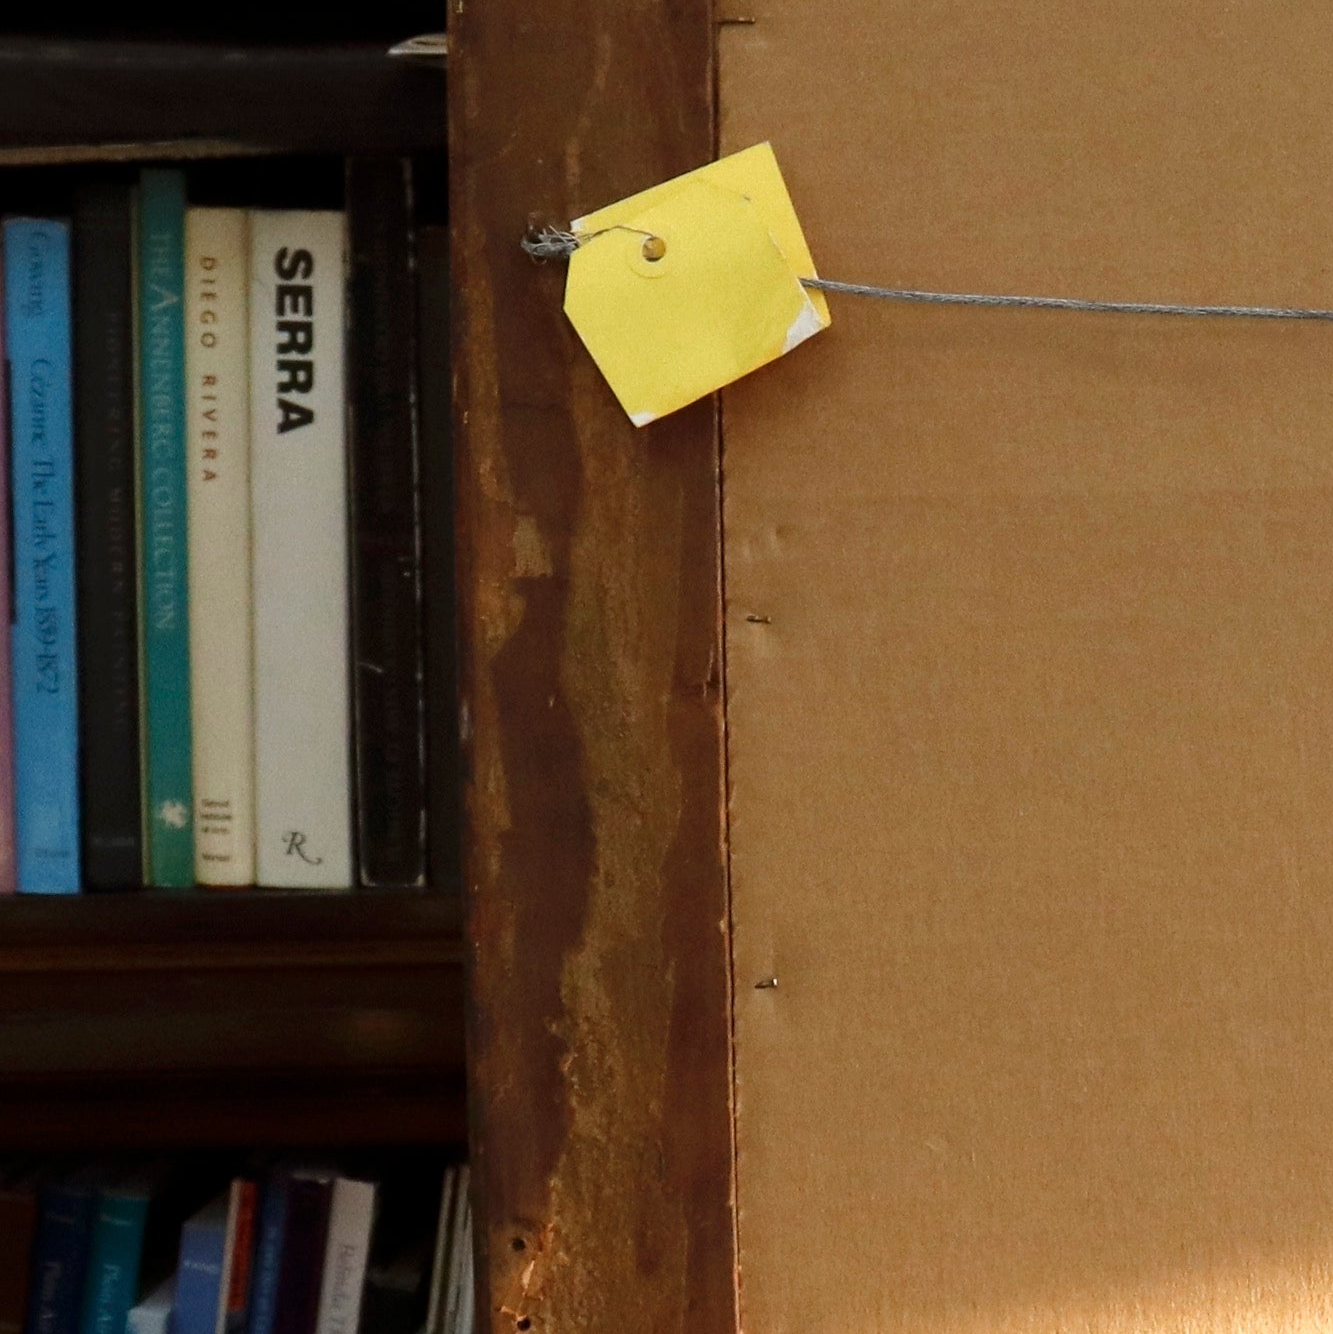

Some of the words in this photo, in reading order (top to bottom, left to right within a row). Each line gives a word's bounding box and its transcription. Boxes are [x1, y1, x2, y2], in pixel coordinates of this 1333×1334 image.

[198, 255, 218, 349] DIEGO
[274, 246, 315, 435] SERRA
[198, 374, 218, 483] RIVERA
[150, 466, 176, 631] COLLECTION
